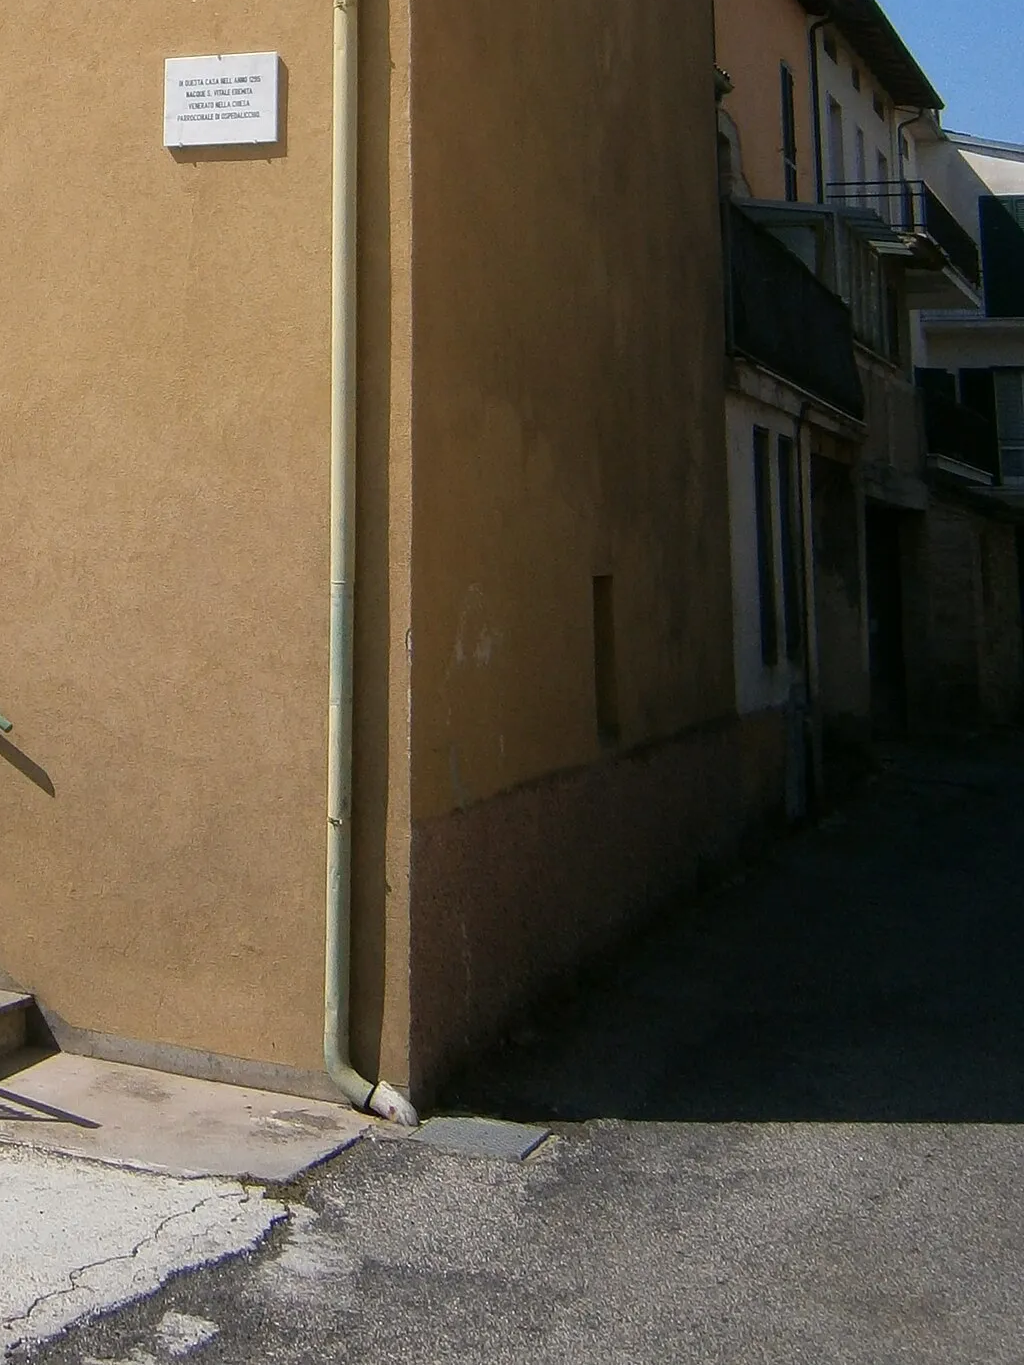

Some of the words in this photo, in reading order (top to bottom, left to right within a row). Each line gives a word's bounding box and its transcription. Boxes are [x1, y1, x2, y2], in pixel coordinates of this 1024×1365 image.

[185, 79, 204, 87] QUESTA
[205, 78, 219, 86] CASA
[186, 90, 206, 98] NACQUE
[232, 88, 254, 96] EREMITA
[188, 102, 214, 110] VENERATO
[215, 101, 231, 109] NELLA
[232, 100, 250, 108] CHIESA
[177, 114, 214, 122] PARROCCHIALE
